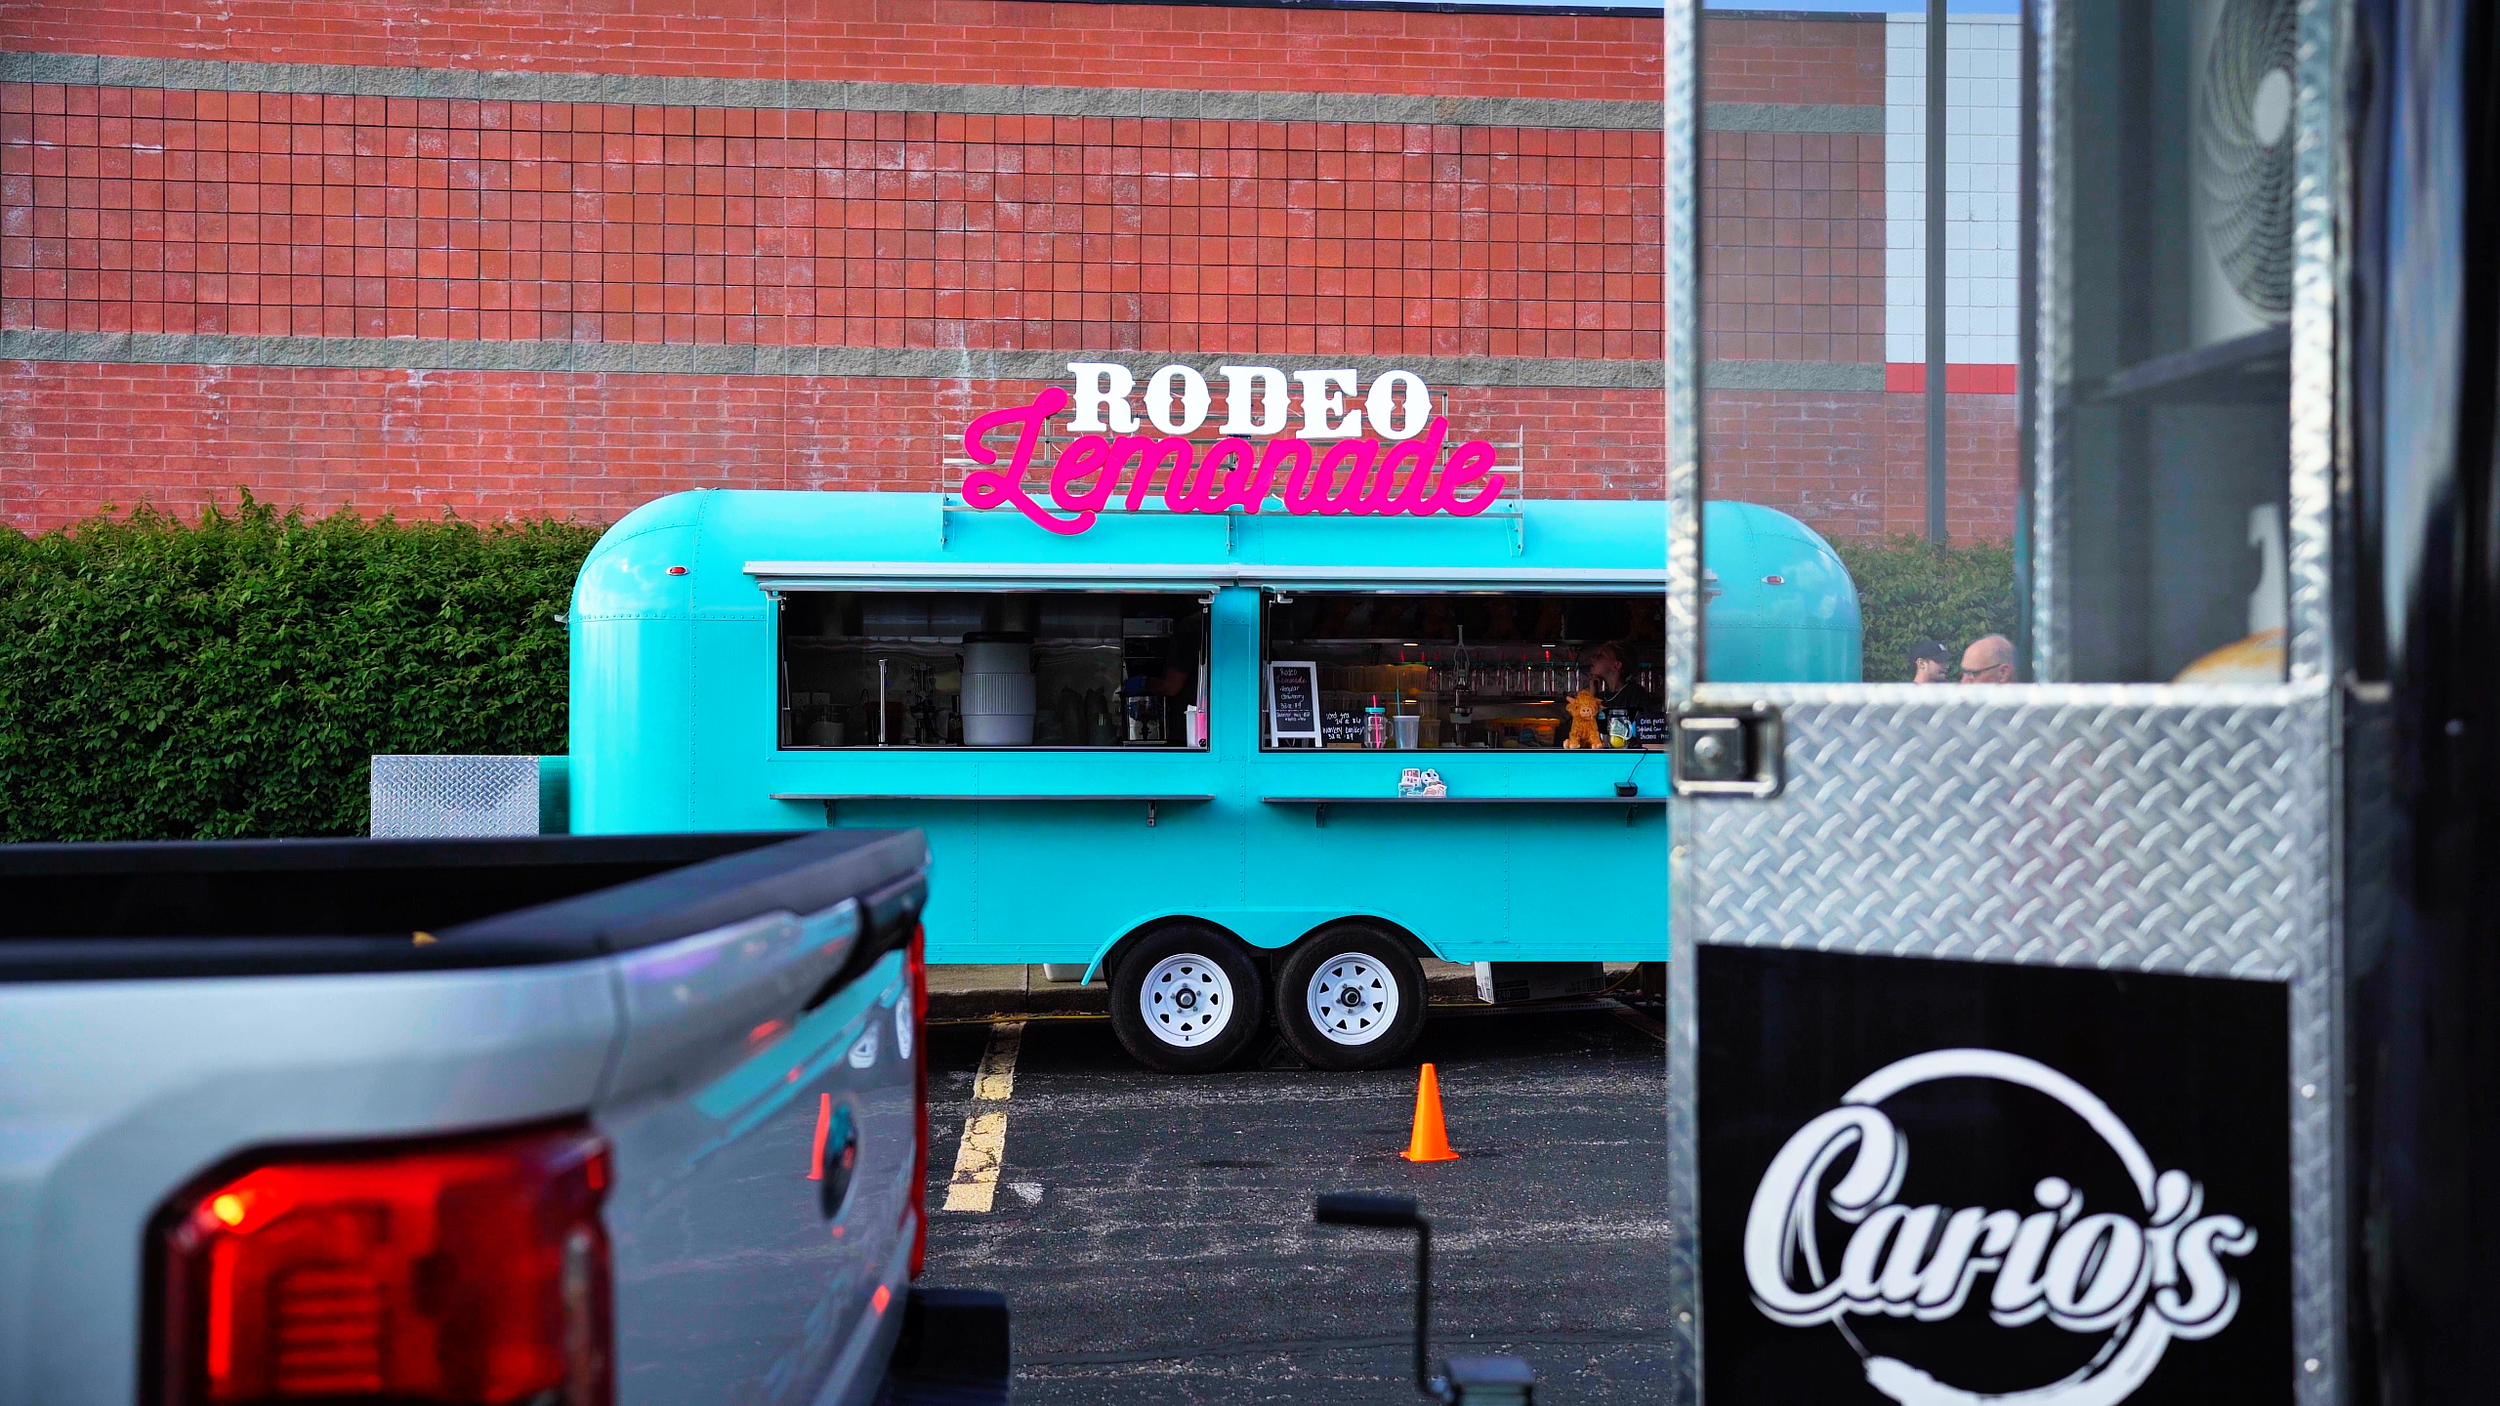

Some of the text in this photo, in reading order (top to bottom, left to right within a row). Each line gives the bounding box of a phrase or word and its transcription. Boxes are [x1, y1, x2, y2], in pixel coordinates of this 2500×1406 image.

[961, 387, 1506, 536] Lemonade
[1066, 362, 1434, 440] RODEO
[1744, 1104, 2258, 1340] Cario's
